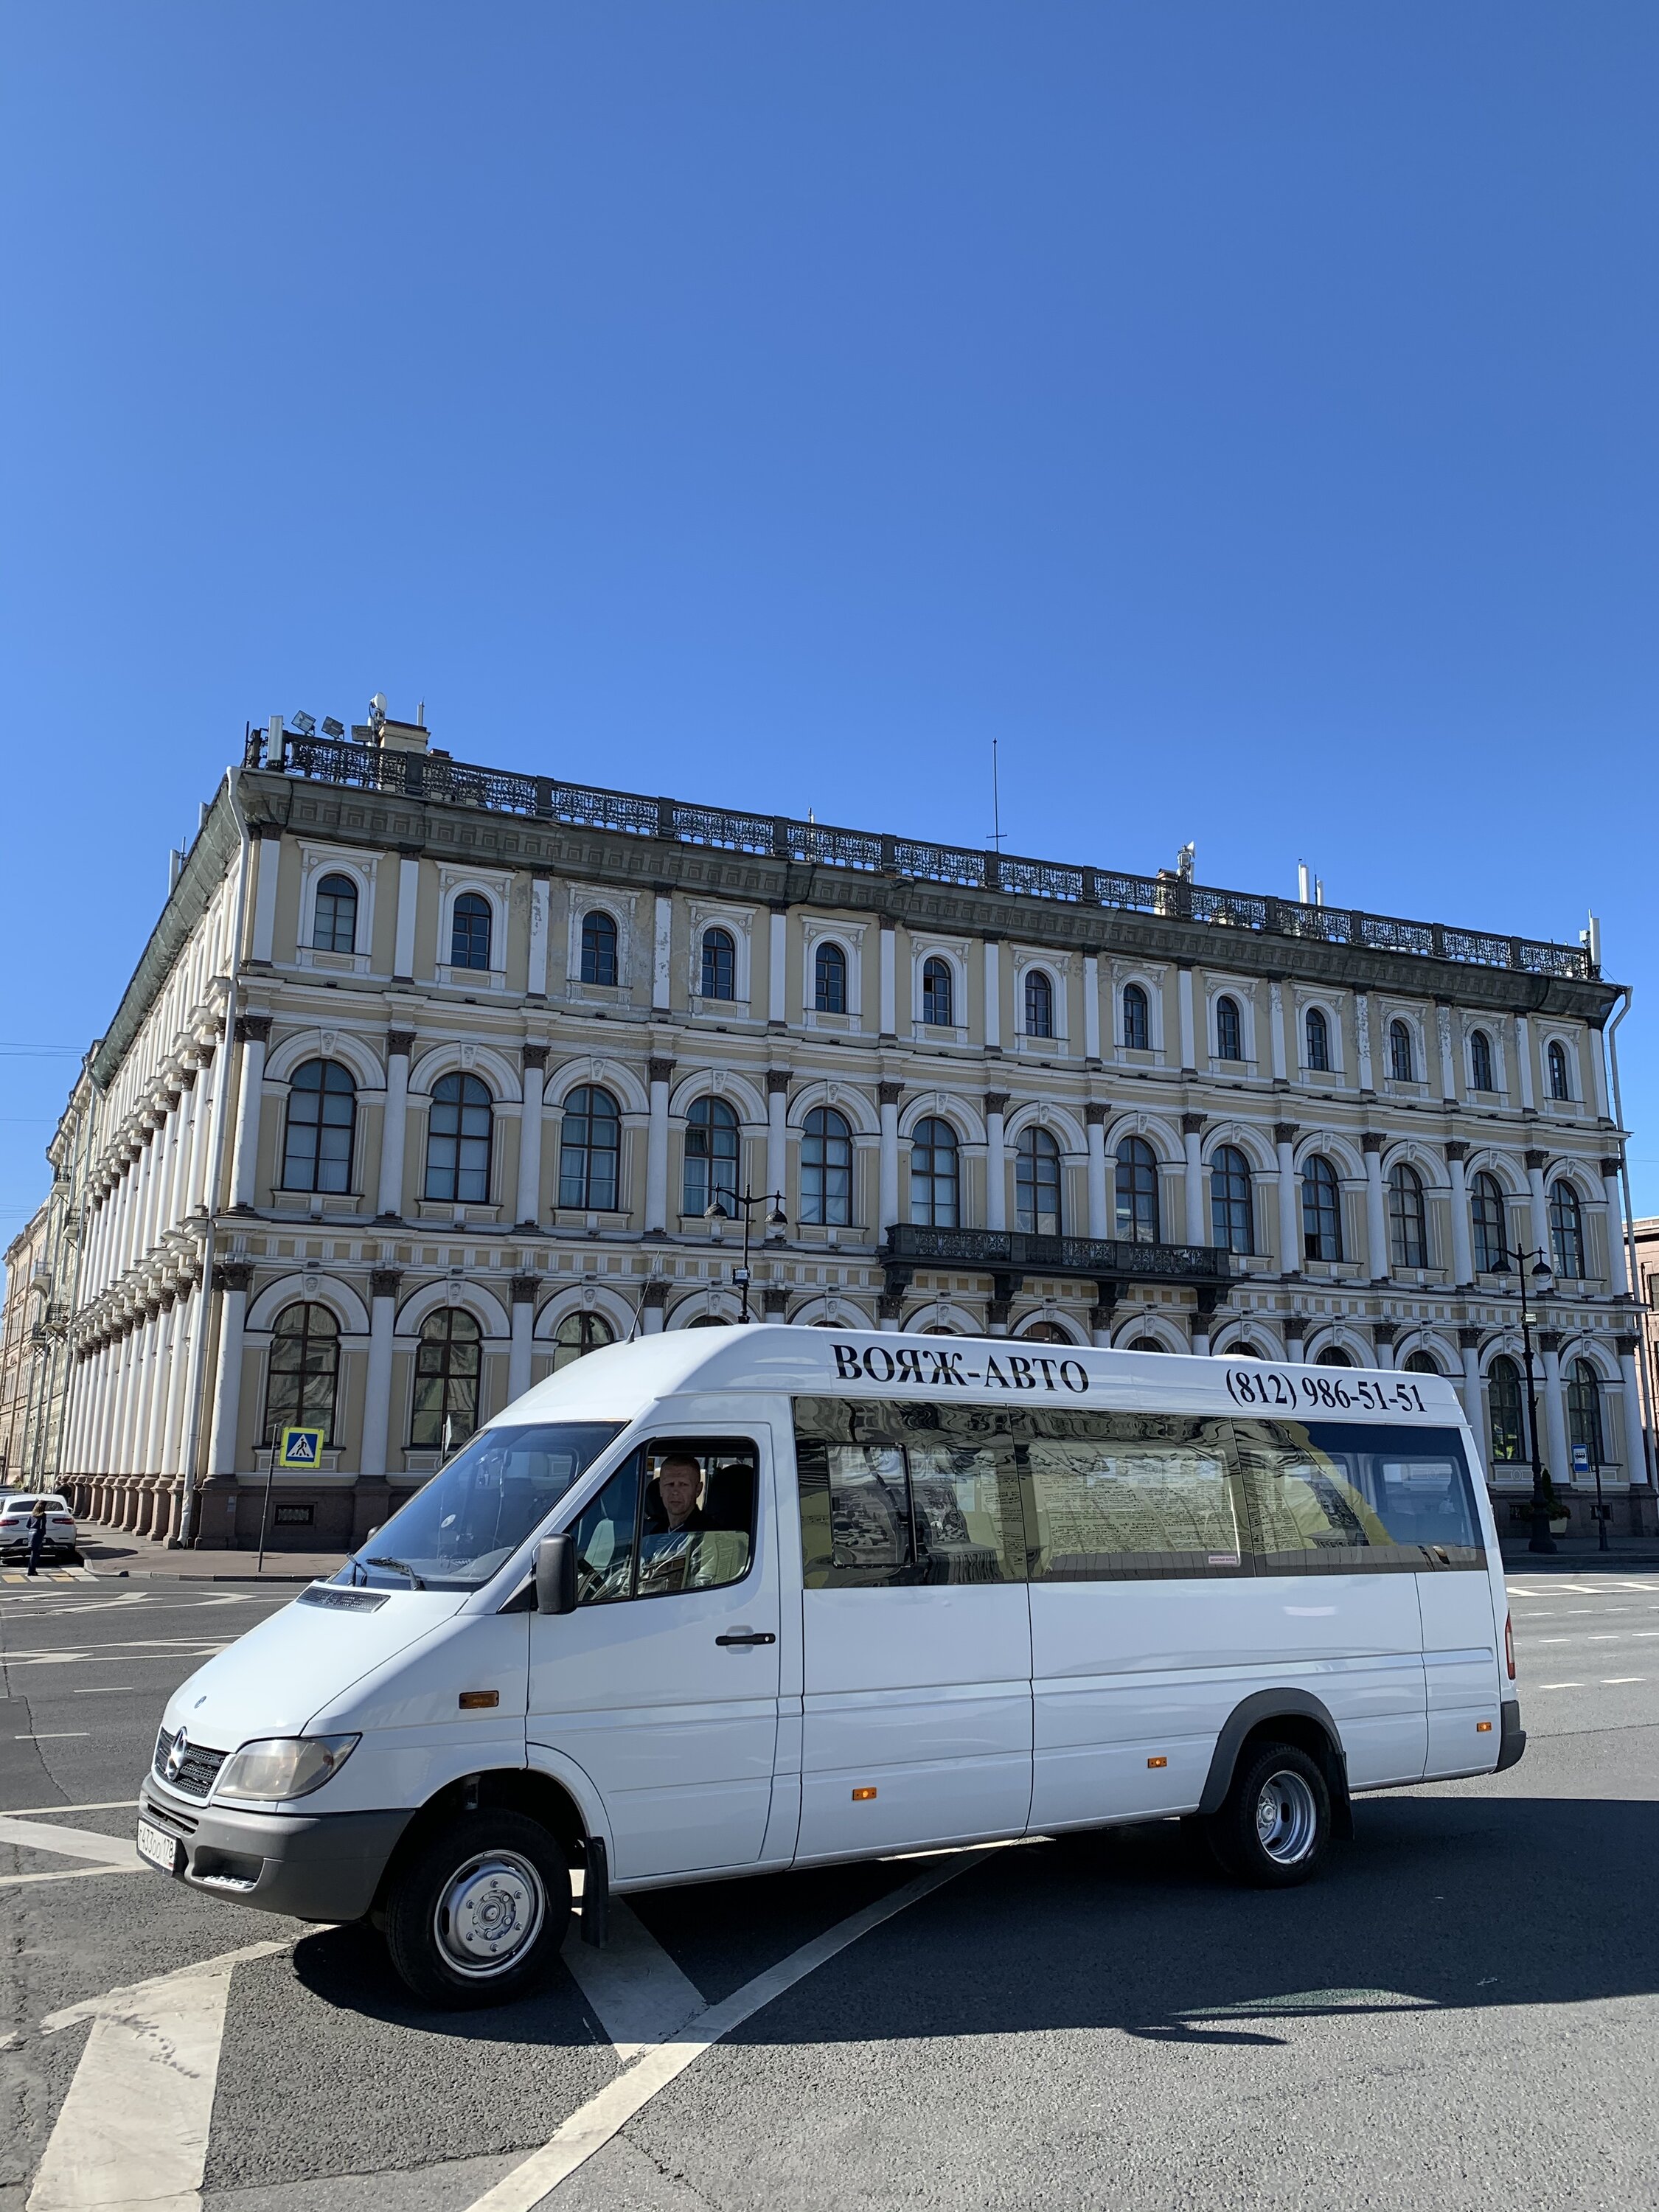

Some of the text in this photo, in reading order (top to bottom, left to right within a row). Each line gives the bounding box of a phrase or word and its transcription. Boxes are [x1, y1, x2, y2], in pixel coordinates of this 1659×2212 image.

[830, 1344, 1089, 1393] ВОЯЖ-АВТО
[1225, 1368, 1427, 1413] (812) 986-51-51
